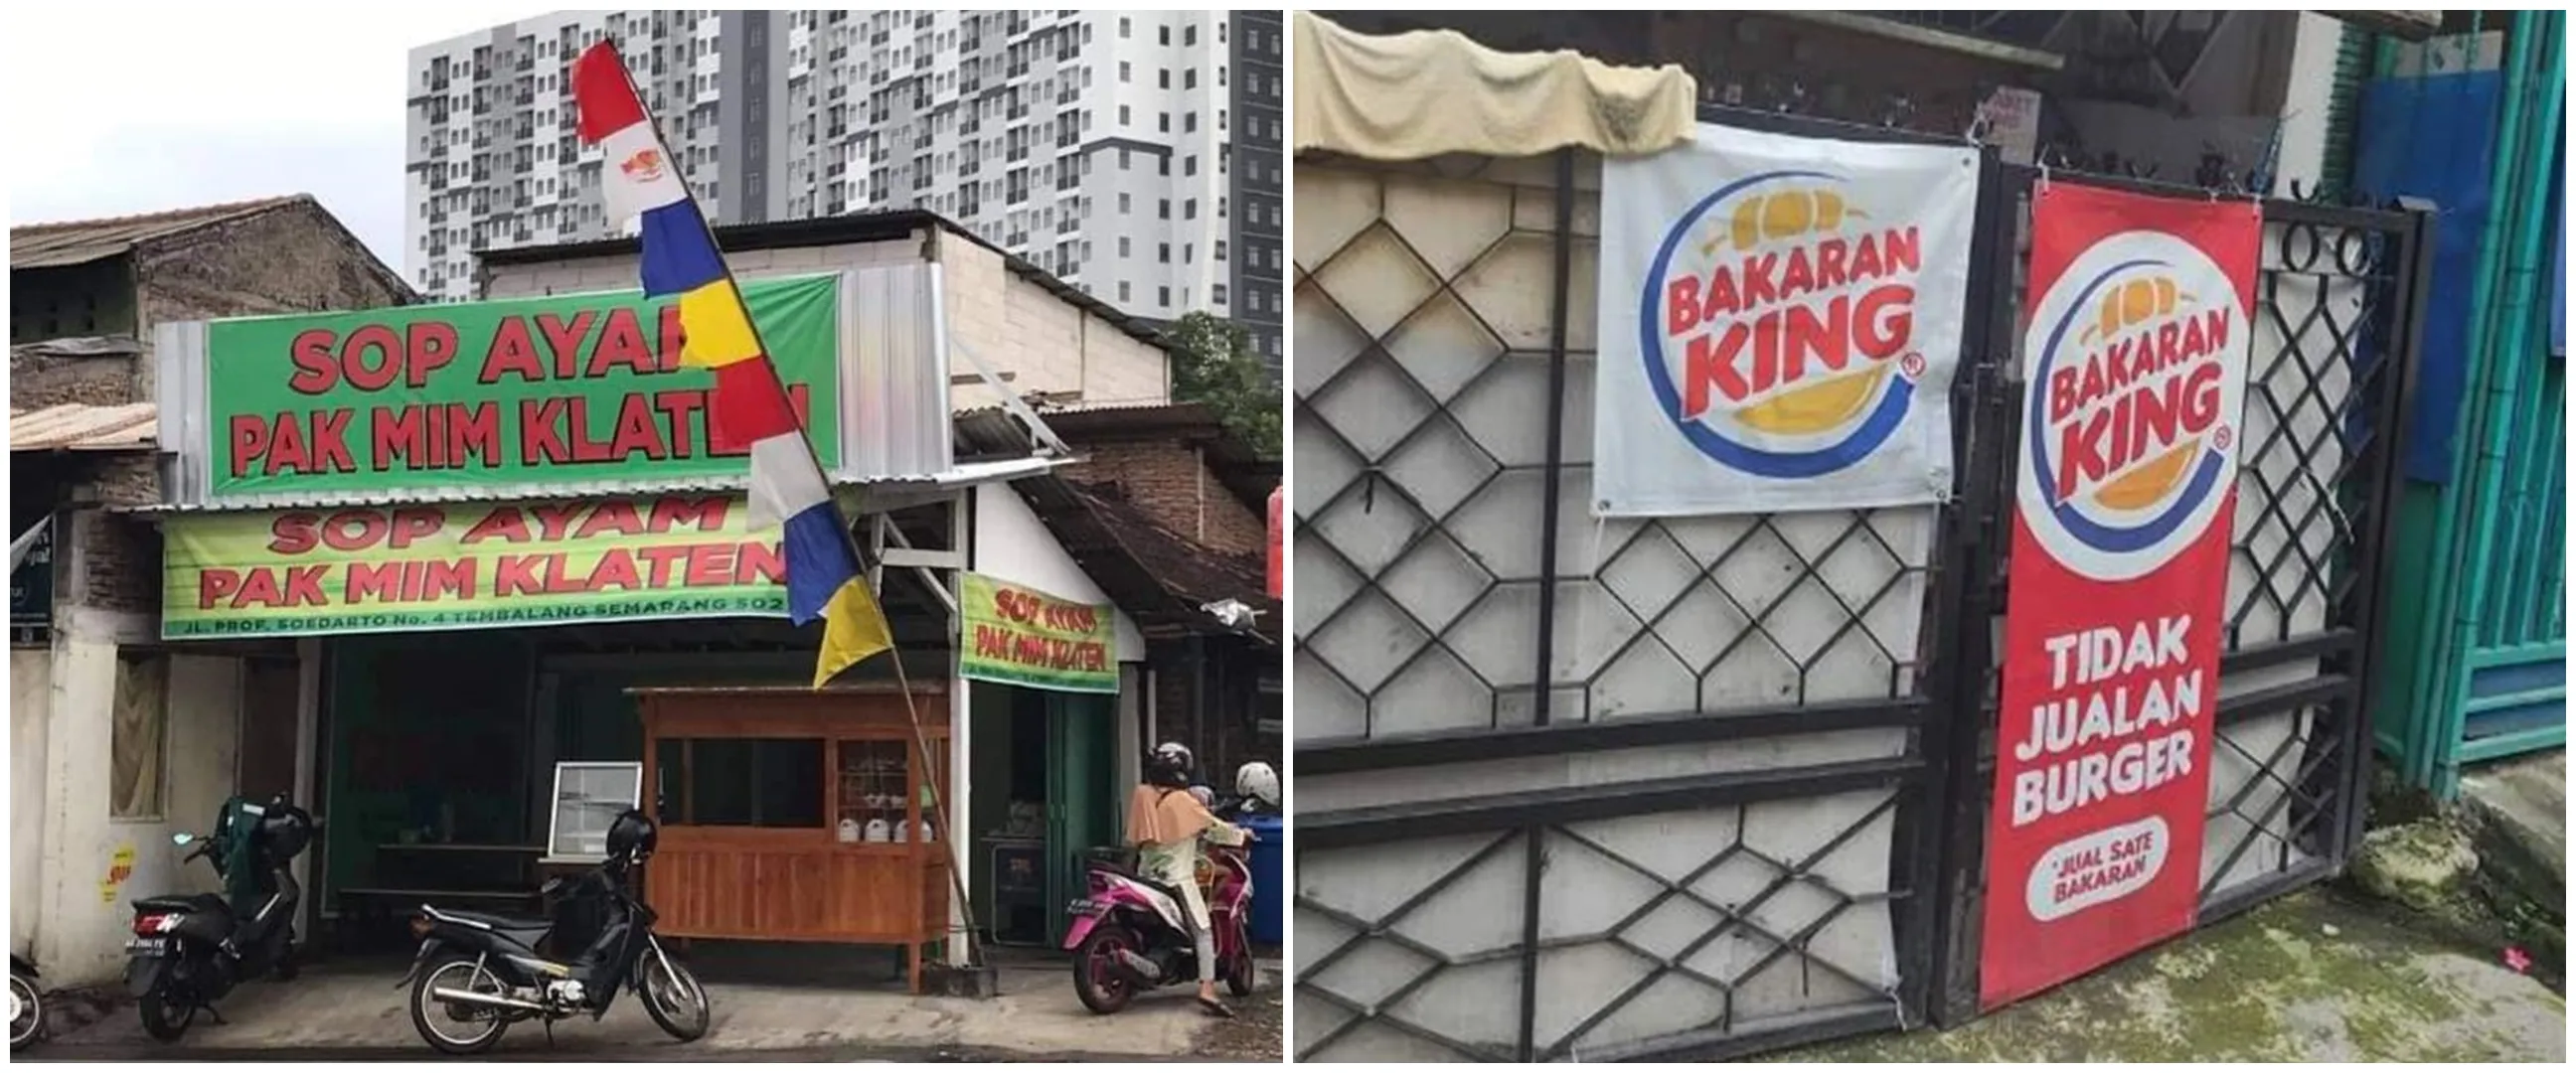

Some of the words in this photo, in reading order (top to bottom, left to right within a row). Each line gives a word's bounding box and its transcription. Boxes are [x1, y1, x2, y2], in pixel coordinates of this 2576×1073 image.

[1667, 226, 1921, 337] BAKARAN
[290, 321, 458, 393] SOP
[1681, 283, 1915, 419] KING
[2049, 306, 2230, 425] BAKARAN
[230, 408, 357, 477] PAK
[372, 399, 502, 471] MIM
[2056, 362, 2223, 505] KING
[266, 509, 445, 554] SOP
[462, 497, 728, 544] AYAM
[198, 564, 329, 610] PAK
[345, 556, 478, 604] MIM
[494, 541, 788, 597] KLATEN
[995, 588, 1042, 627] SOP
[215, 616, 270, 633] PROF.
[432, 610, 445, 624] 4
[454, 604, 588, 626] TEMBALANG
[596, 597, 726, 617] SEMARANG
[976, 624, 1012, 661] PAK
[2044, 614, 2191, 690] TIDAK
[2014, 669, 2203, 761] JUALAN
[2012, 729, 2194, 828] BURGER
[2054, 854, 2147, 904] BAKARAN
[2109, 831, 2154, 861] SATE
